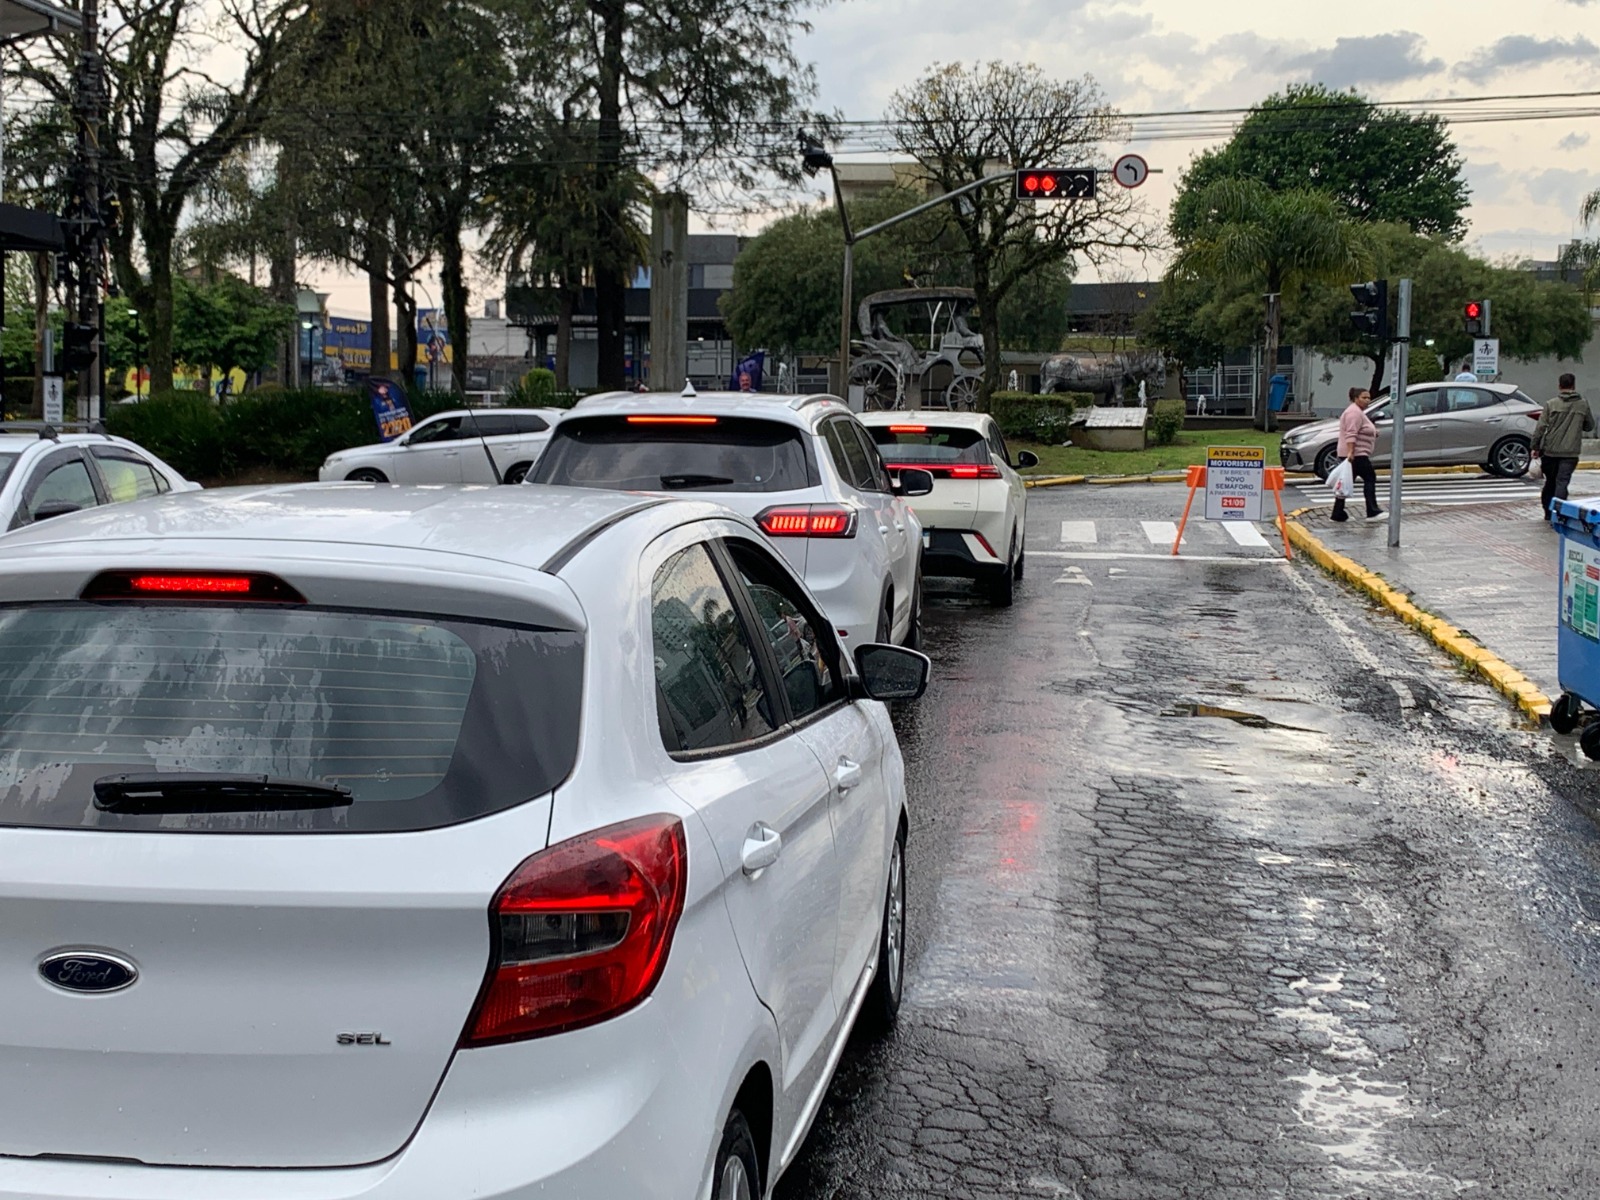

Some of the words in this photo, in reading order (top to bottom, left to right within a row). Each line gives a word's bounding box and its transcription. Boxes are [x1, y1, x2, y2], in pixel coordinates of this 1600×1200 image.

[1222, 499, 1245, 507] 21/09
[57, 958, 112, 985] Ford
[336, 1031, 391, 1045] SEL
